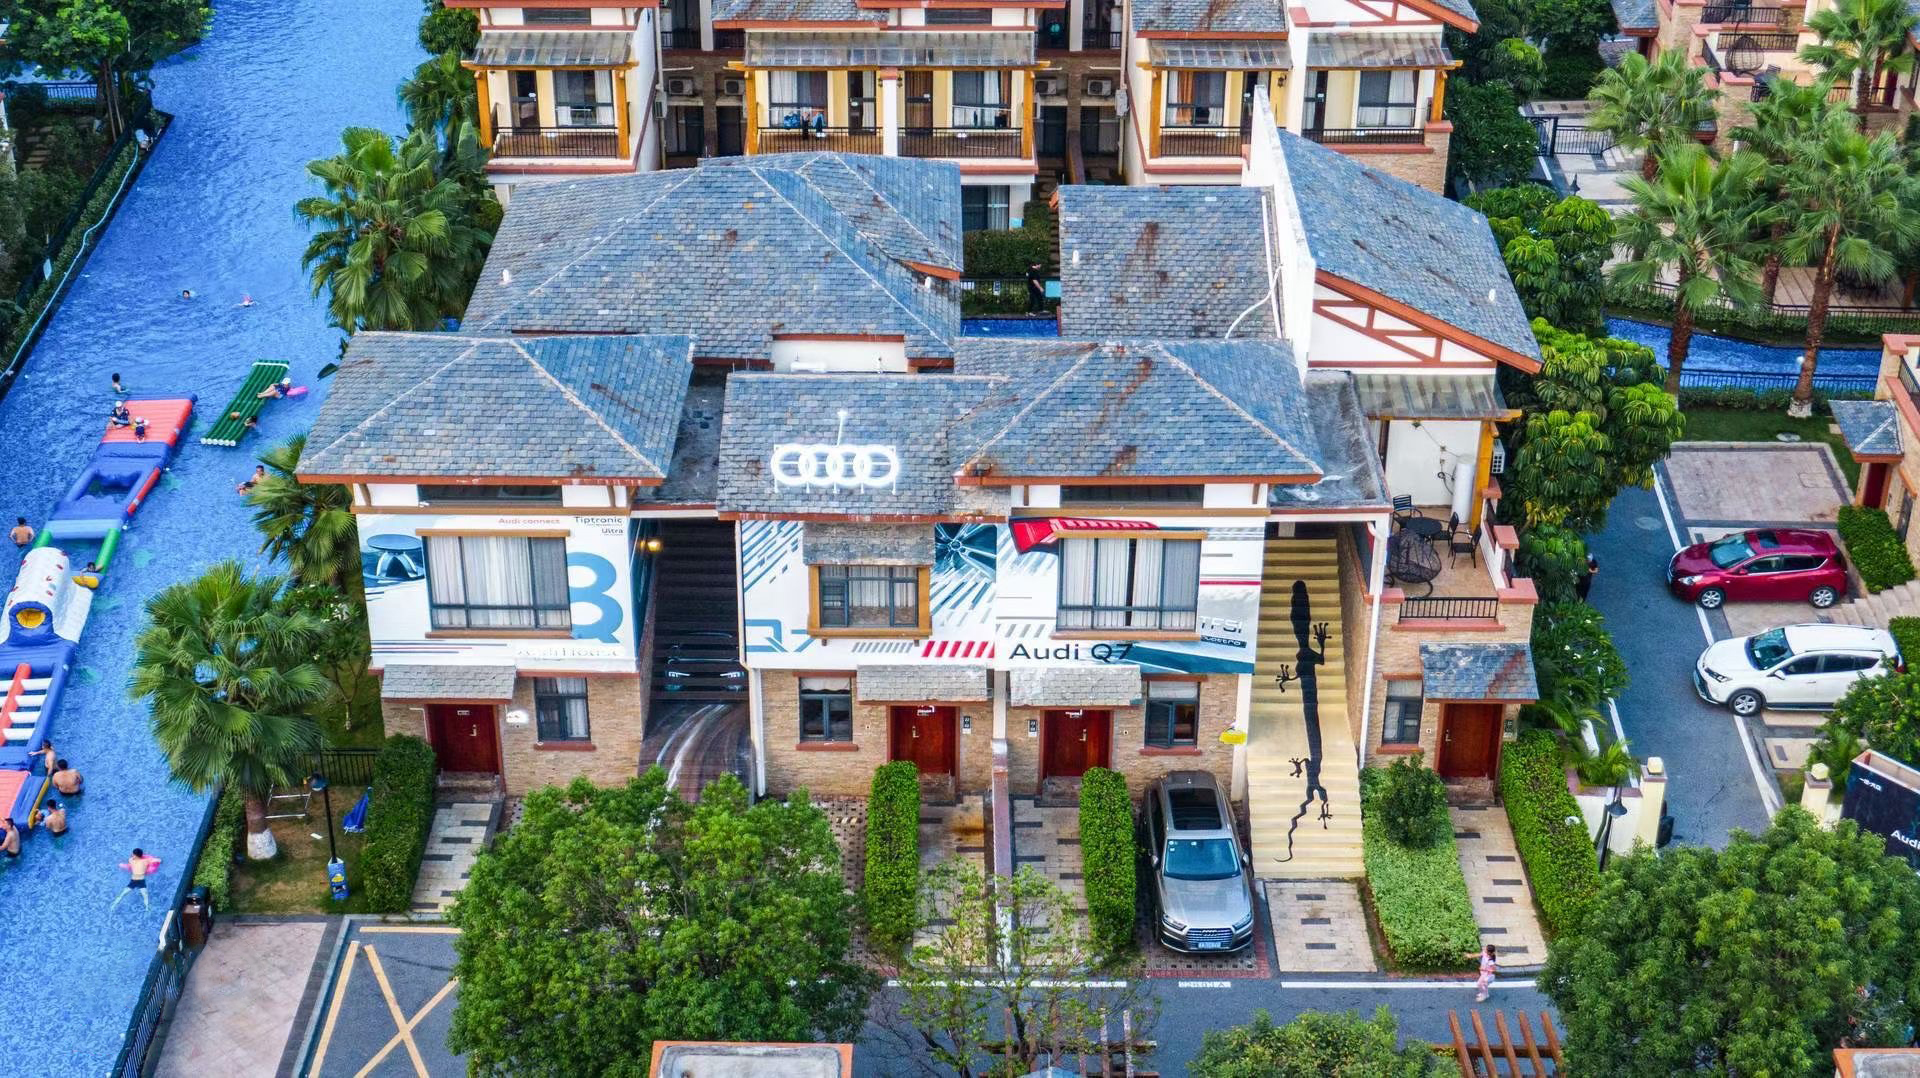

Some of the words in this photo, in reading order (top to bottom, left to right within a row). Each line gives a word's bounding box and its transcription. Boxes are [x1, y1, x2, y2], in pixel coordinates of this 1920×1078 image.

[574, 516, 623, 524] Tiptronic
[1008, 643, 1080, 660] Audi
[1091, 642, 1134, 663] Q7
